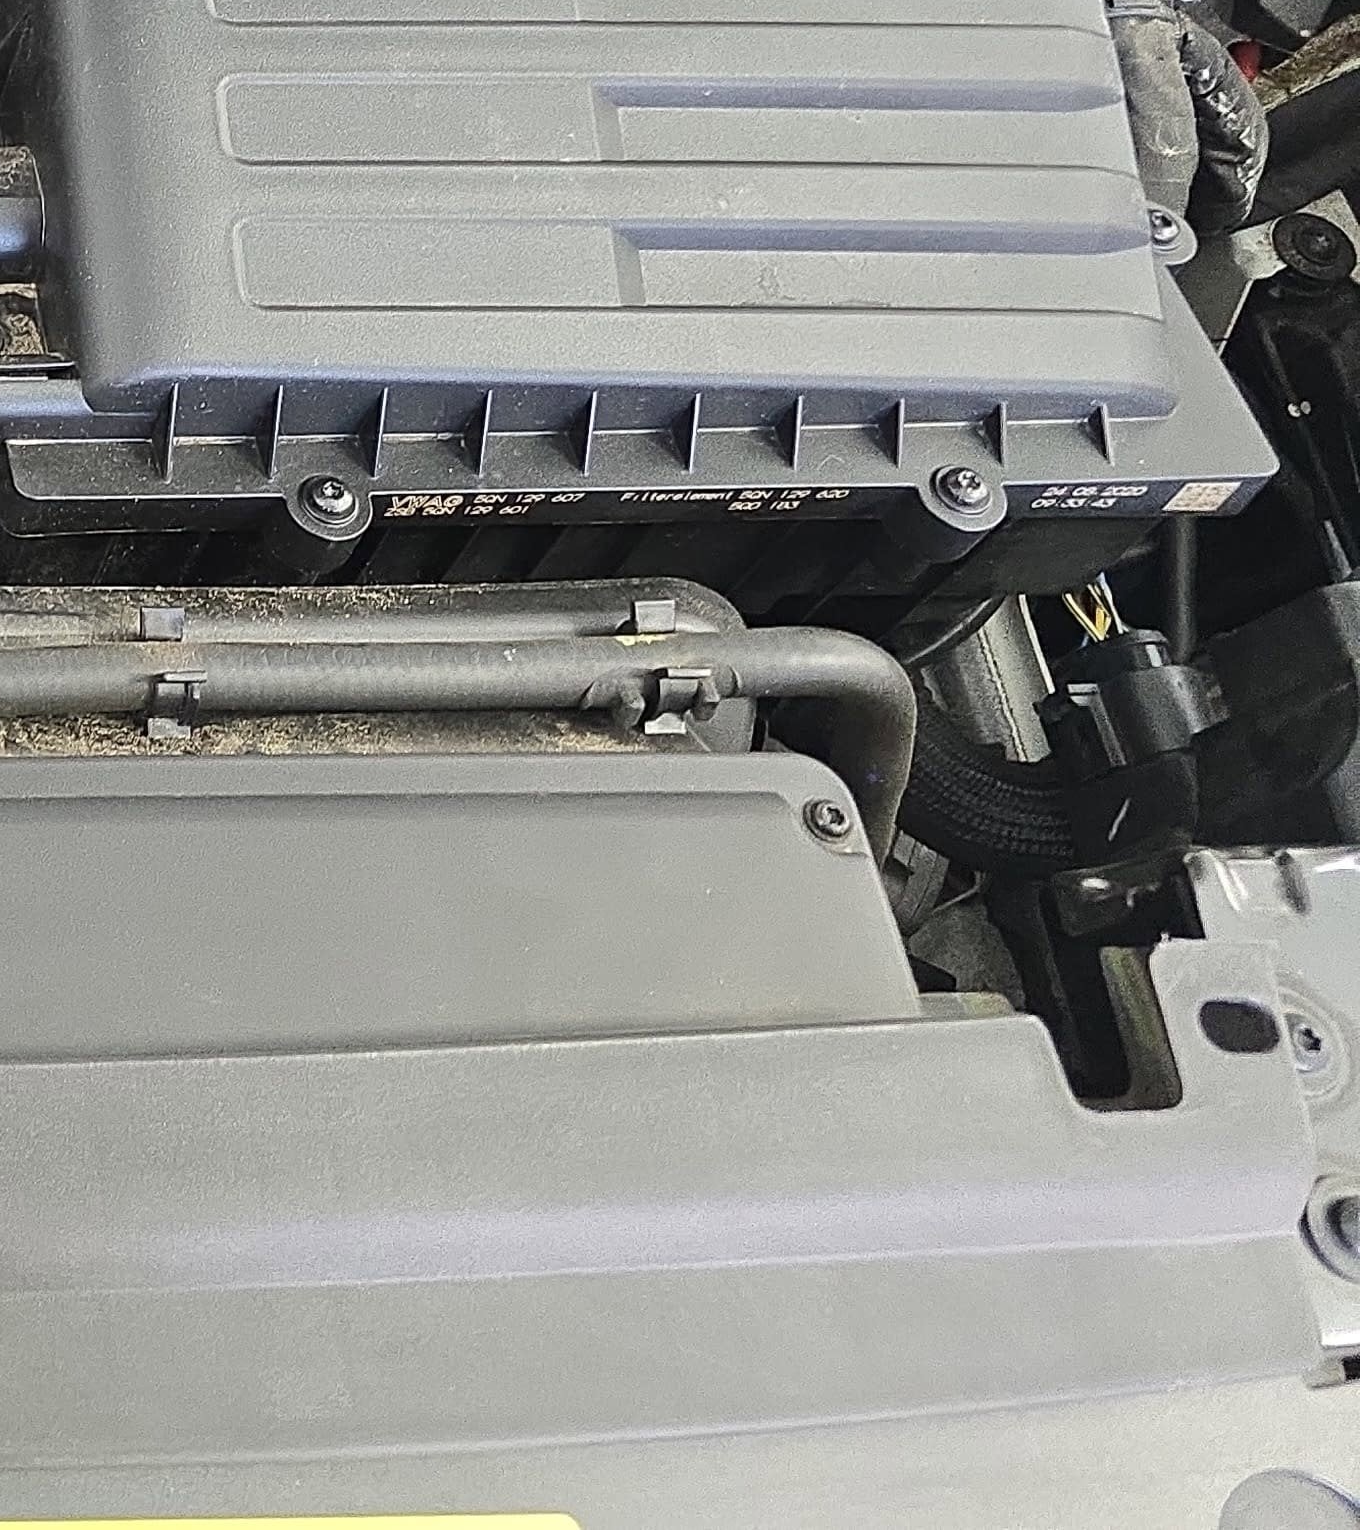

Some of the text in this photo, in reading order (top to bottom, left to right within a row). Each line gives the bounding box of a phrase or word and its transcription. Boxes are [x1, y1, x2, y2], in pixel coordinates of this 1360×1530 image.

[473, 494, 507, 503] 5QN
[516, 494, 546, 503] 129
[551, 493, 586, 503] 607
[620, 490, 734, 501] Filterelement
[780, 489, 811, 499] 129
[815, 489, 850, 498] 620
[464, 506, 494, 515] 129
[499, 505, 529, 515] 601
